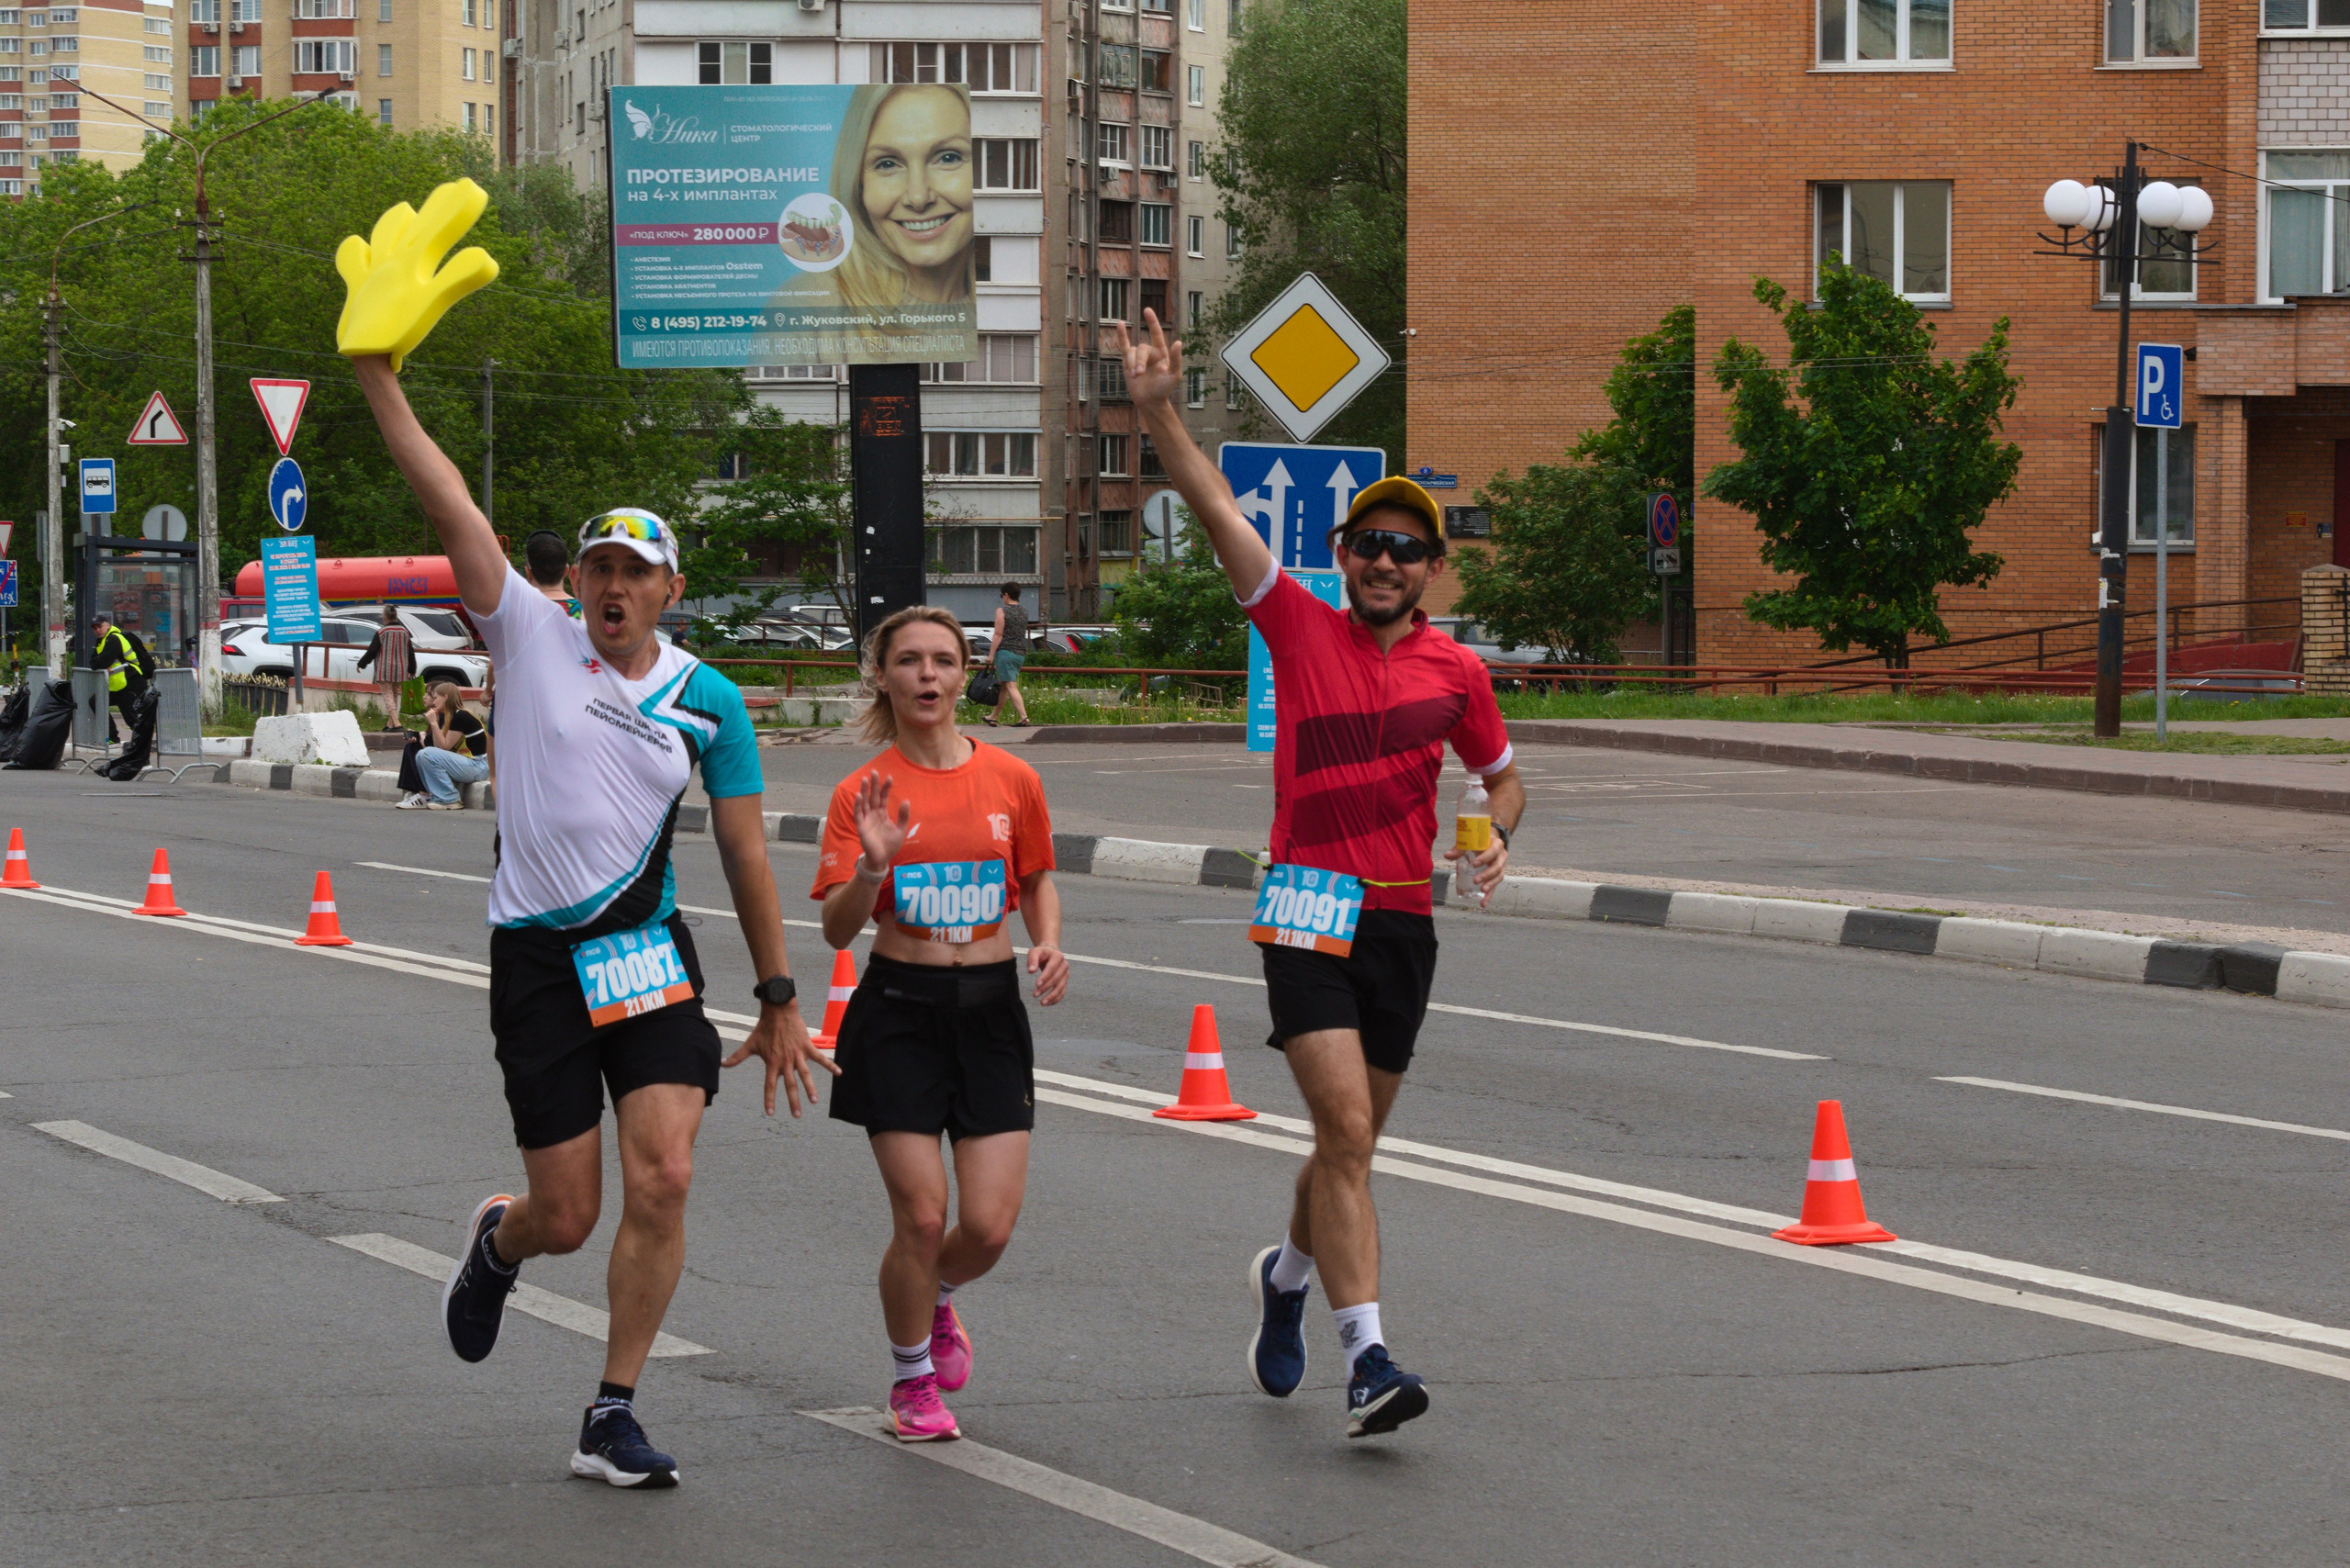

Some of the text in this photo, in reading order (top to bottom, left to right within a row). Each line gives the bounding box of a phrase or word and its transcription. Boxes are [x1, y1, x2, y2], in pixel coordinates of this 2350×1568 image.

[653, 114, 718, 144] Ника
[731, 124, 833, 133] СТОМАТОЛОГИЧЕСКИЙ
[731, 135, 761, 143] ЦЕНТР
[627, 167, 820, 184] ПРОТЕЗИРОВАНИЕ
[628, 188, 778, 202] на 4-х имплантах
[630, 231, 655, 241] «ПОД
[657, 230, 688, 240] КЛЮЧ»
[726, 262, 763, 271] Osstem
[651, 313, 966, 330] 8 (495) 212-19-74 г. Жуковский, ул. Горького 5
[632, 340, 676, 358] ИМЕЮТСЯ
[775, 338, 834, 357] НЕОБХОДИМА
[836, 336, 902, 355] КОНСУЛЬТАЦИЯ
[903, 334, 965, 355] СПЕЦИАЛИСТА
[2143, 355, 2165, 416] P
[593, 698, 632, 722] ПЕРВАЯ
[585, 704, 673, 754] ПЕЙСМЕЙКЕРОВ
[901, 883, 1000, 924] 70090
[1262, 885, 1351, 935] 70091
[586, 943, 678, 1003] 70087
